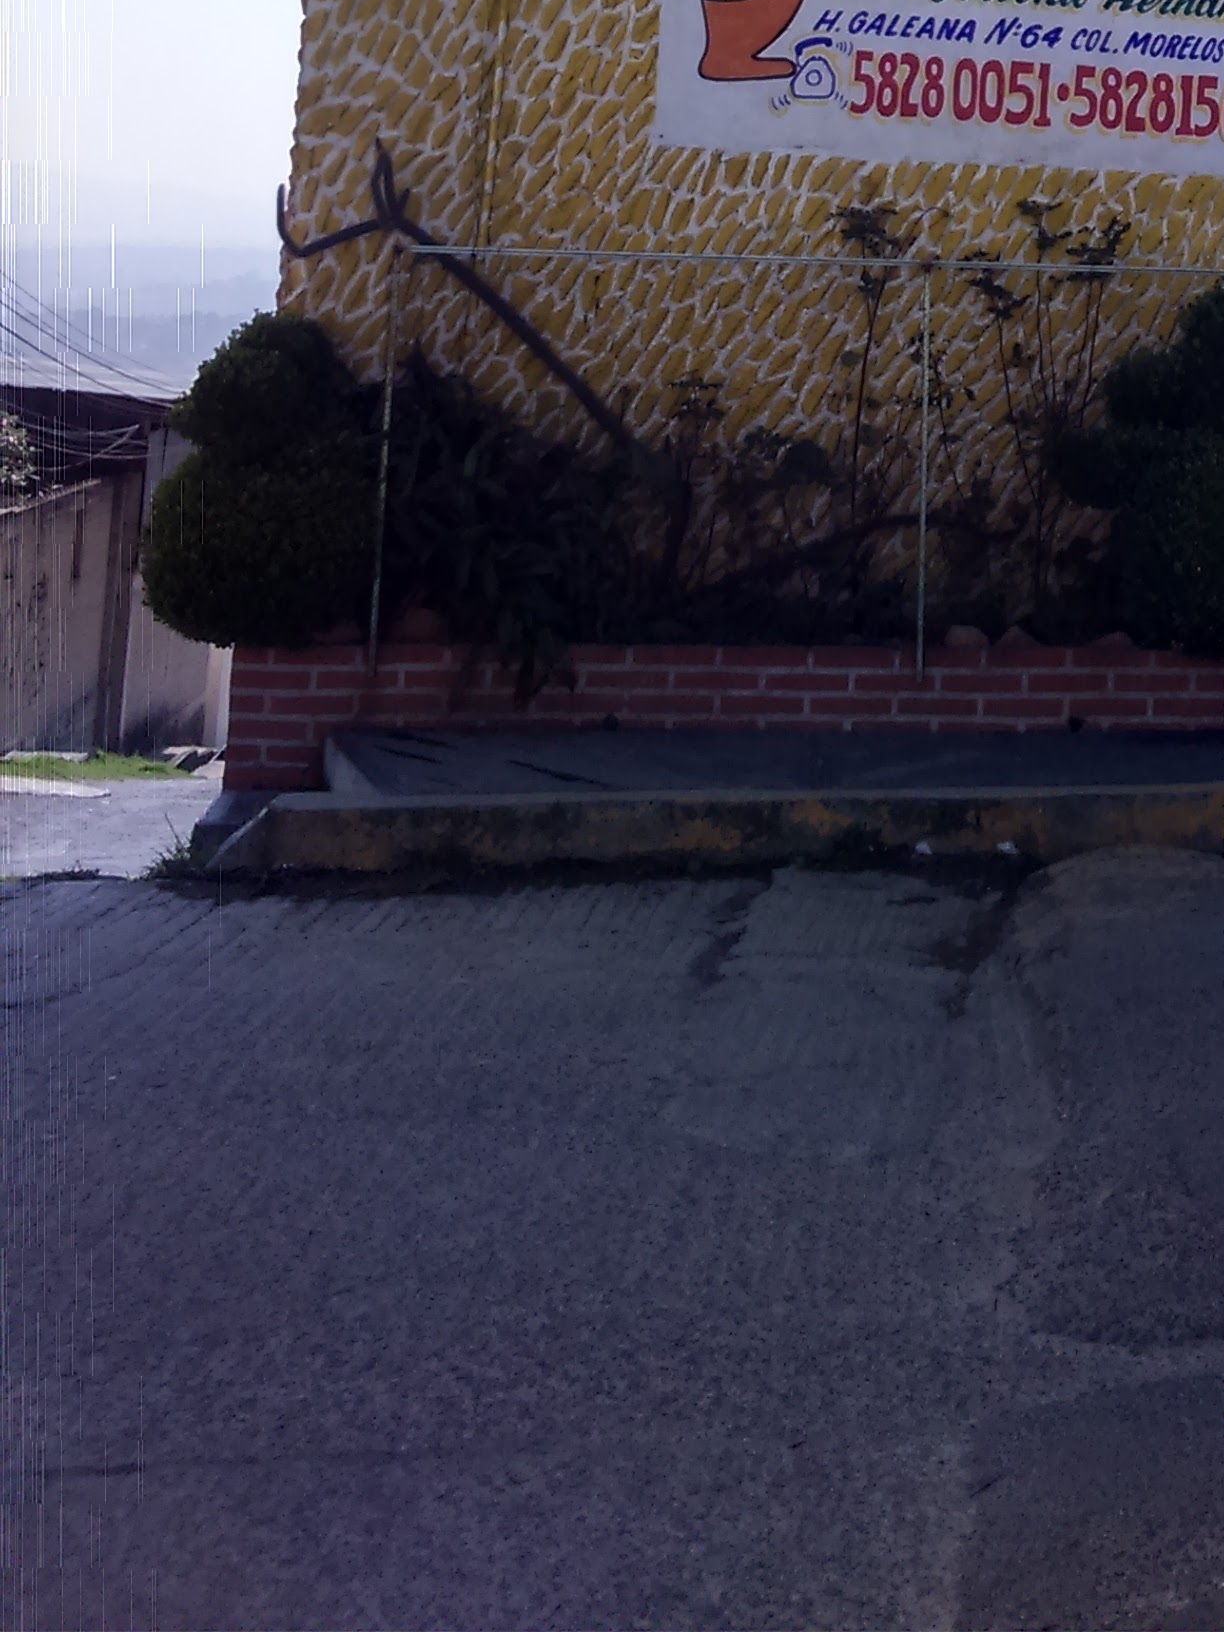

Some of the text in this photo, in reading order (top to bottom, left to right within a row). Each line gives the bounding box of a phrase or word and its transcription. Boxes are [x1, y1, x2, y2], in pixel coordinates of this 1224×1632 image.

[813, 10, 844, 33] H.
[847, 10, 977, 44] GALEANA
[1070, 28, 1119, 55] COL.
